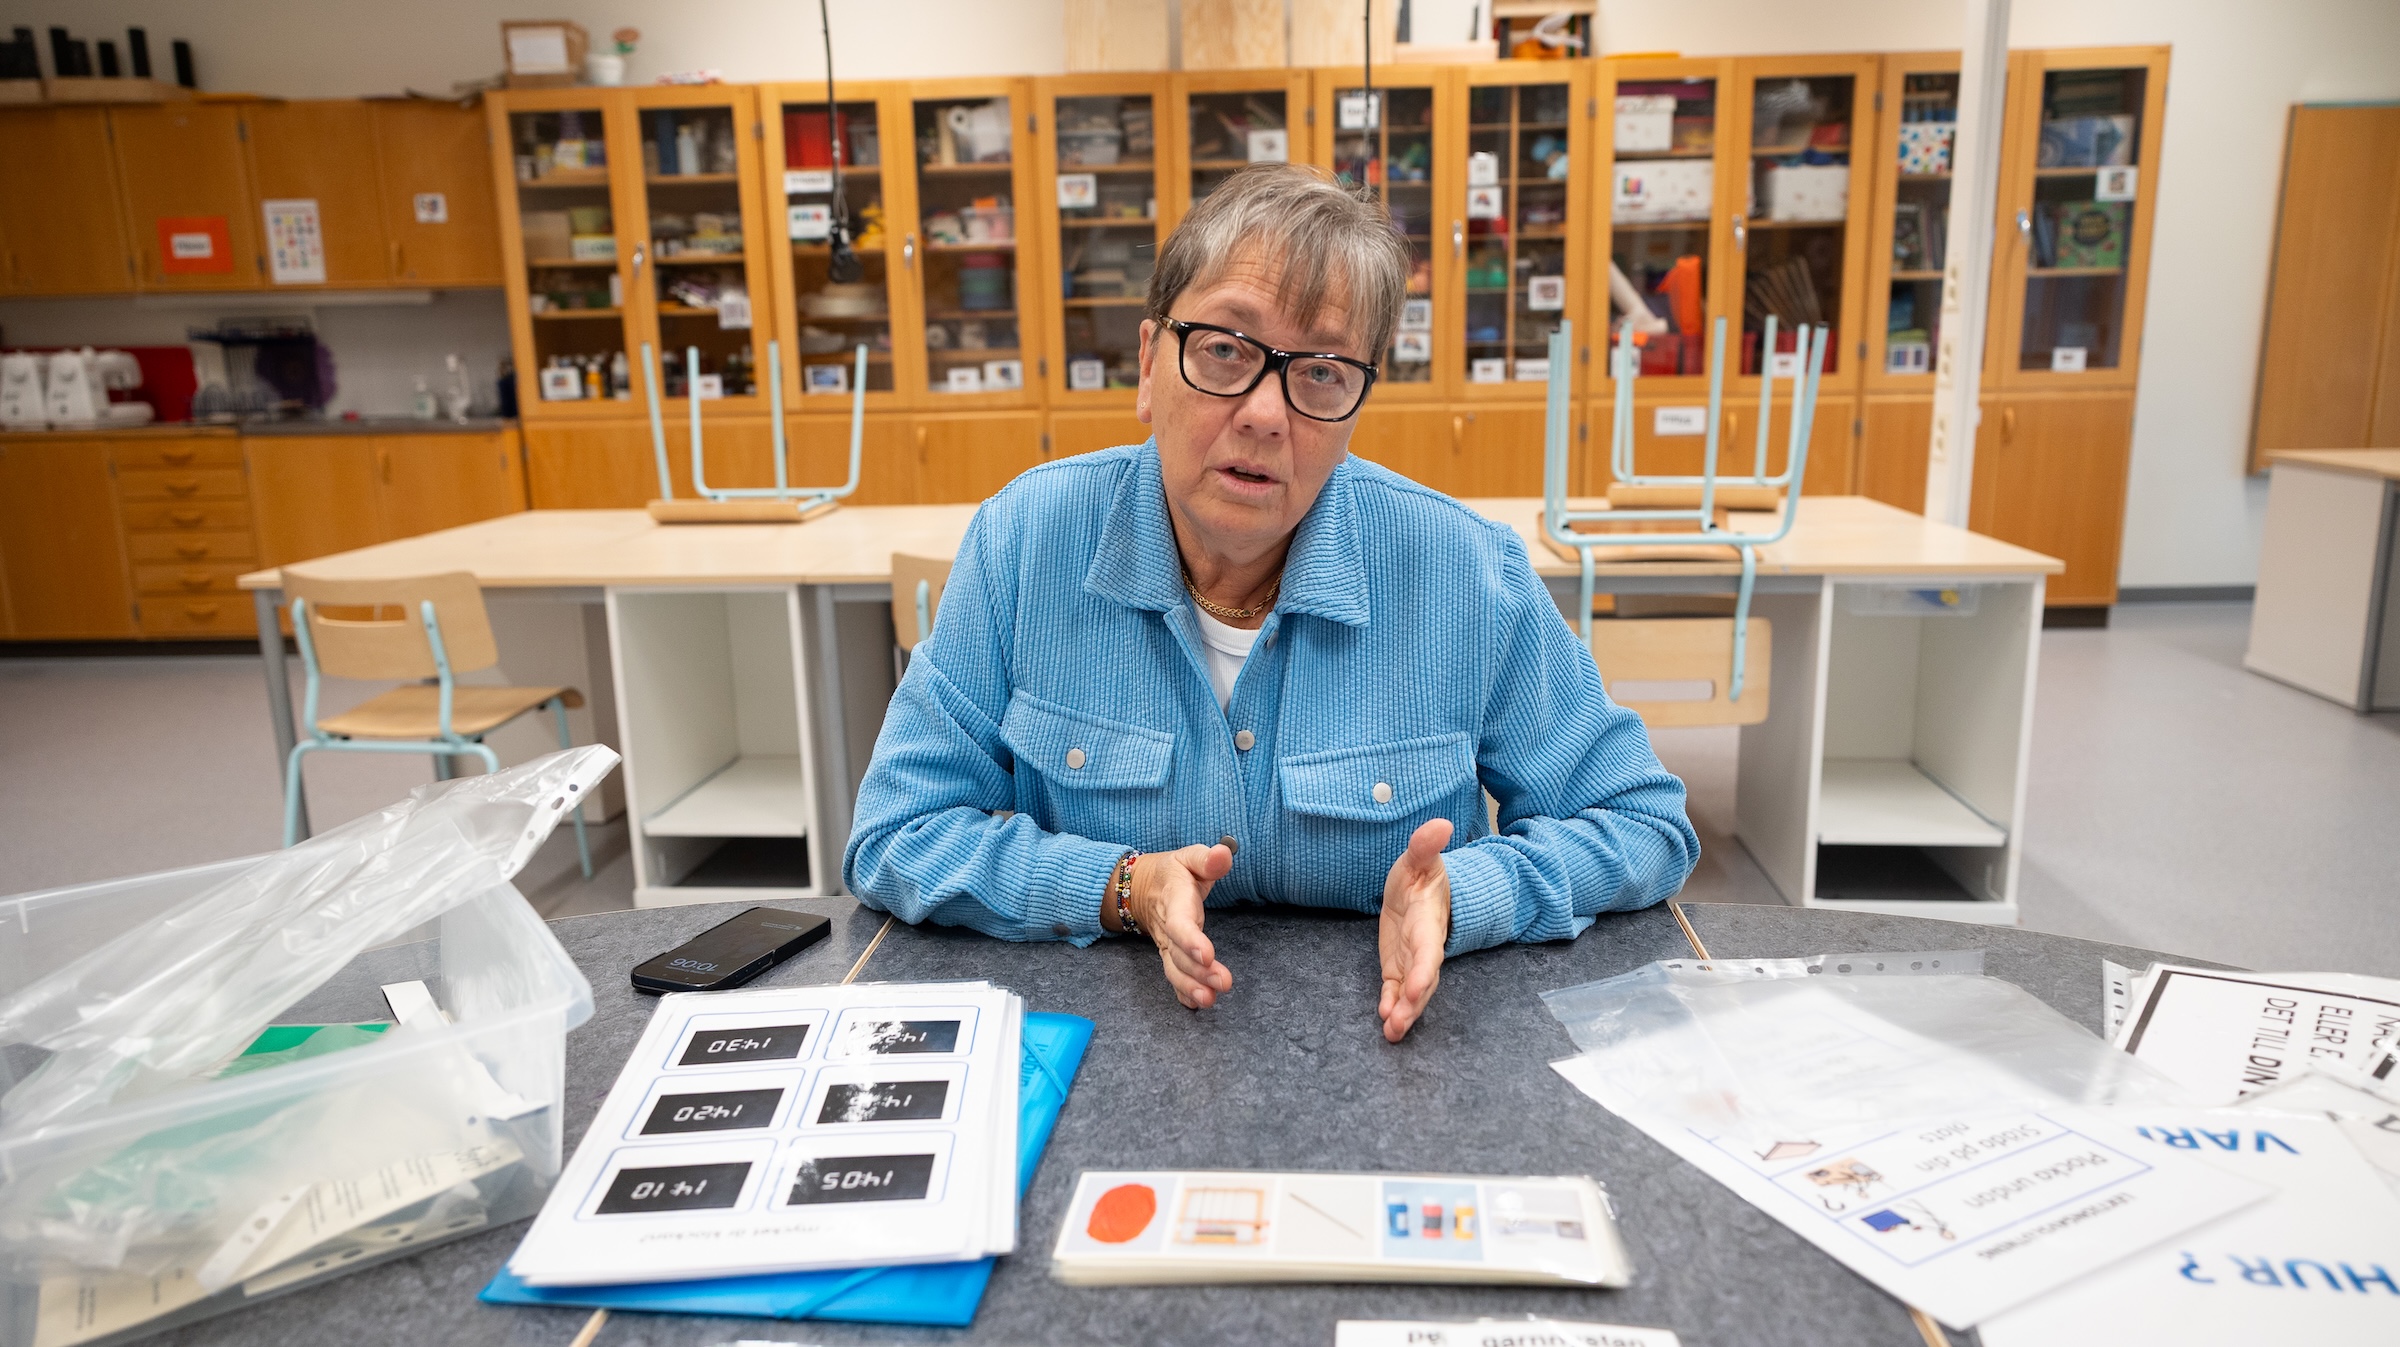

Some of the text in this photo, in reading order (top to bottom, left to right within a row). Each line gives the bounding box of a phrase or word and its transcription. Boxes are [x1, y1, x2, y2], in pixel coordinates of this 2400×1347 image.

[669, 958, 719, 972] 10:06
[2311, 1004, 2354, 1047] ELLER
[706, 1036, 773, 1054] 14:30
[2242, 997, 2298, 1087] DET TILL DIN
[672, 1104, 744, 1122] 14:20
[1915, 1154, 1950, 1172] din
[630, 1179, 708, 1200] 14:10
[820, 1170, 894, 1191] 14:05
[1962, 1150, 2109, 1209] Plocka undan
[2178, 1250, 2400, 1295] HUR ?
